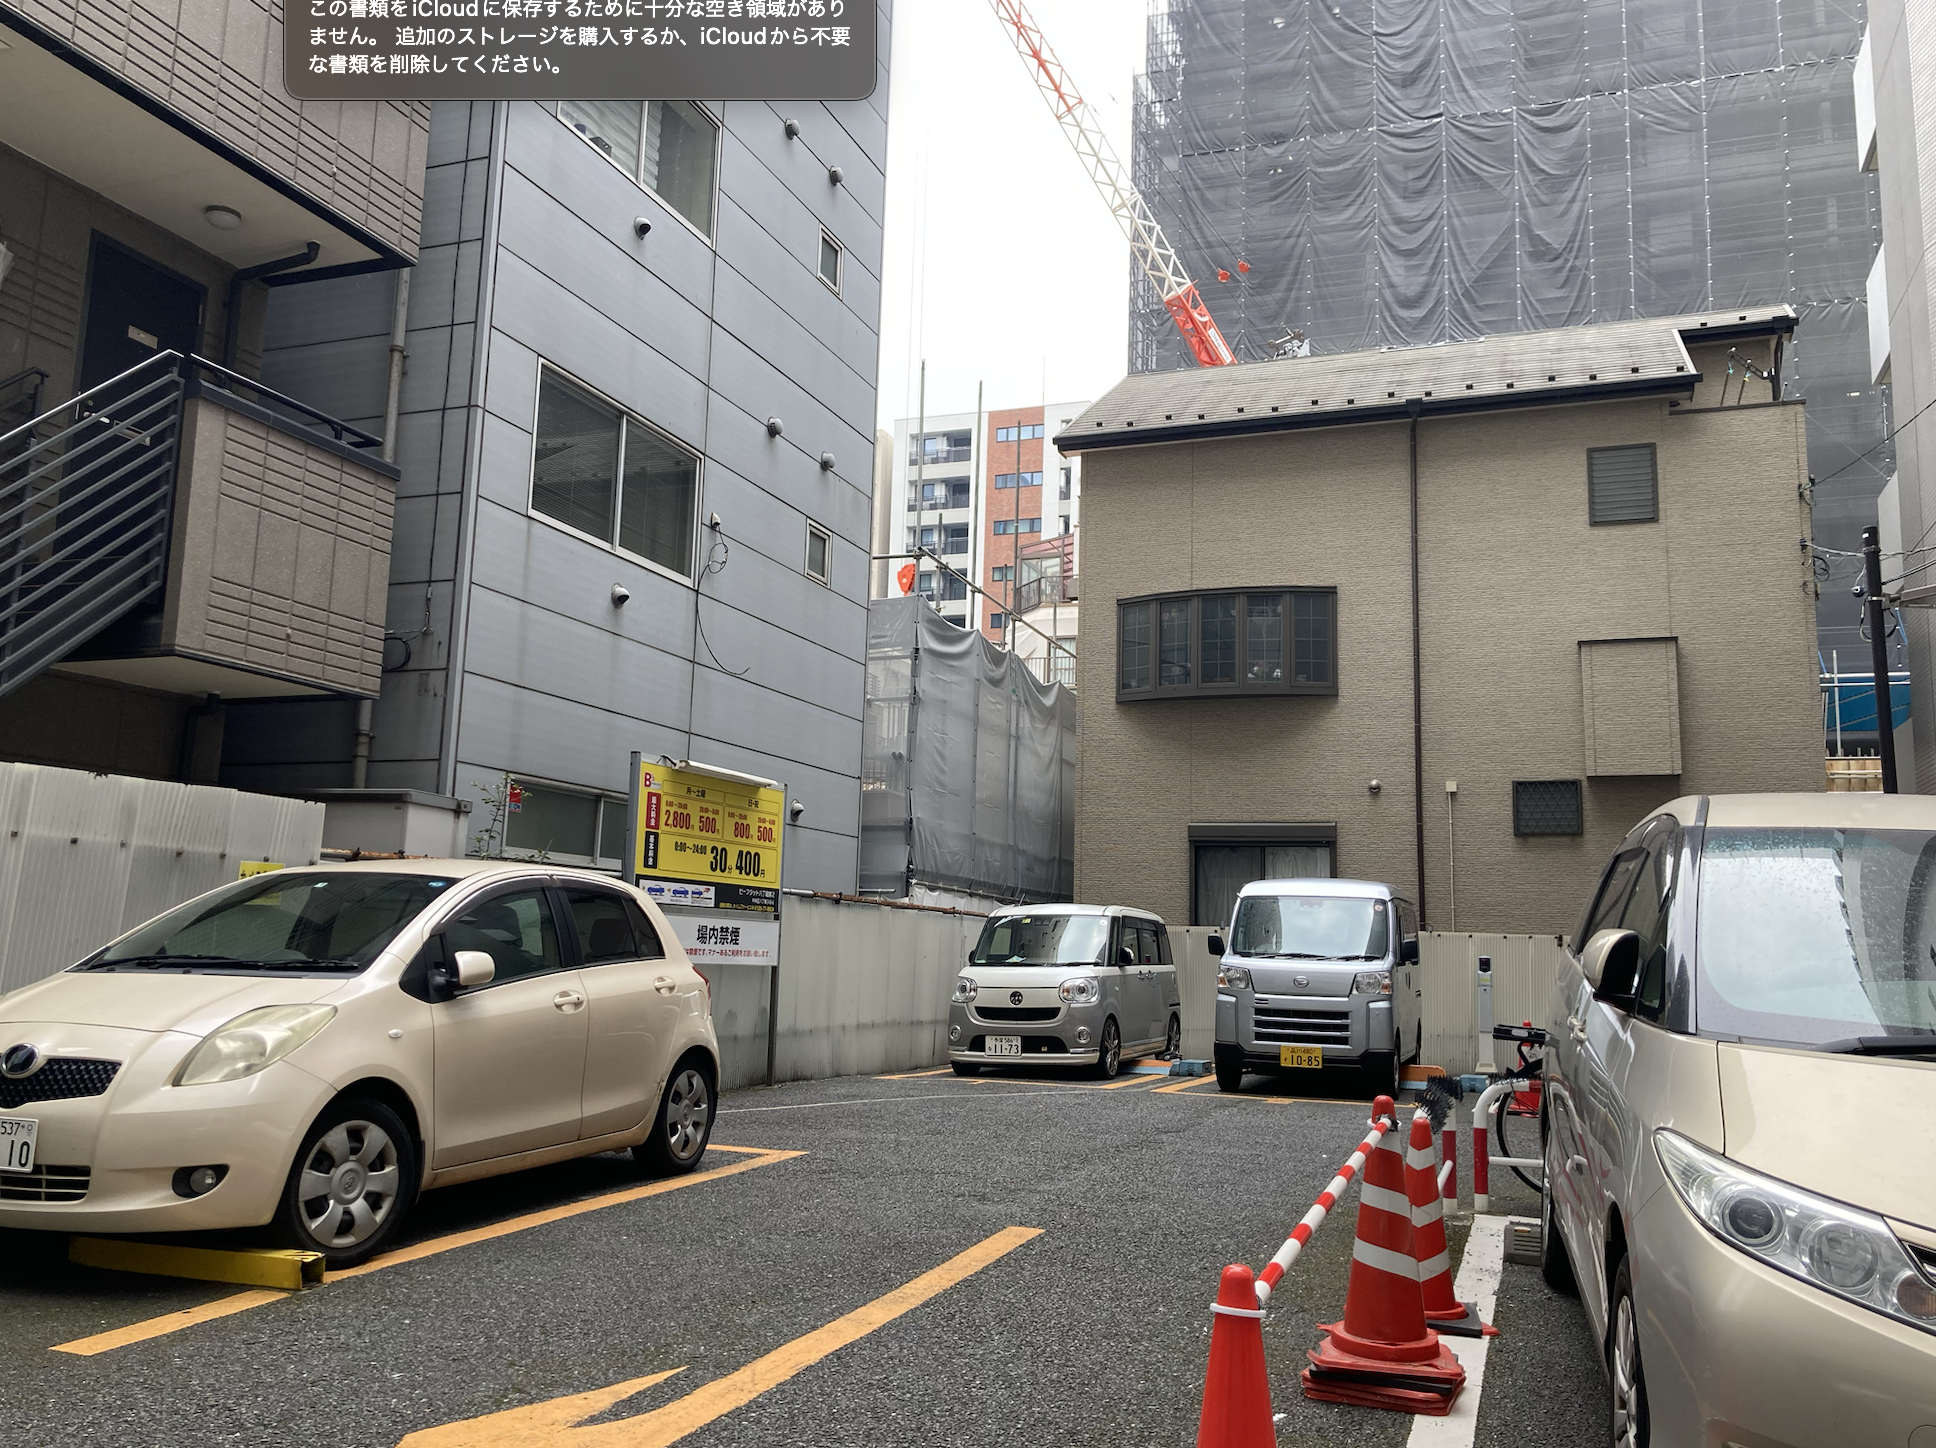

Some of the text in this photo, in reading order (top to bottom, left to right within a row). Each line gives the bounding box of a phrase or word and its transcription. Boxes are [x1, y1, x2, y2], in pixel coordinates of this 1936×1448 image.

[697, 925, 741, 945] 場内禁煙
[994, 1044, 1019, 1054] 11-73
[1291, 1055, 1320, 1066] 10-85
[0, 1121, 21, 1136] 537
